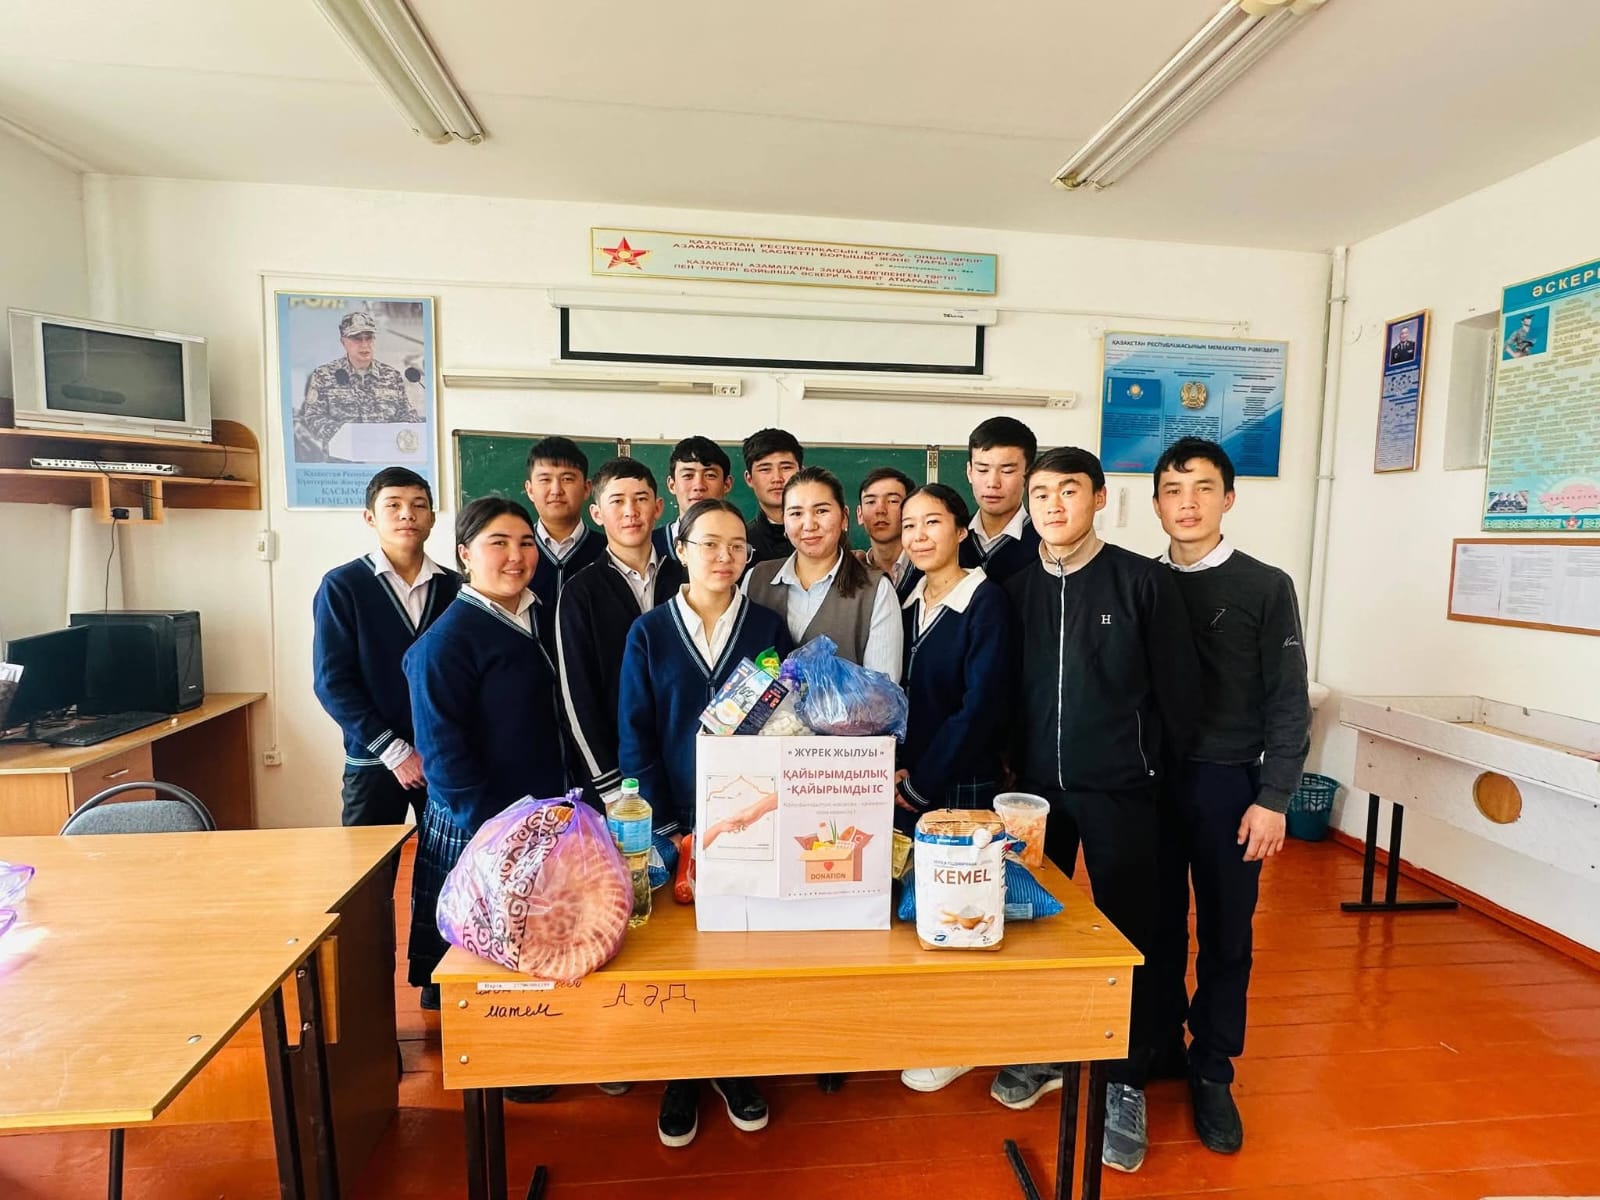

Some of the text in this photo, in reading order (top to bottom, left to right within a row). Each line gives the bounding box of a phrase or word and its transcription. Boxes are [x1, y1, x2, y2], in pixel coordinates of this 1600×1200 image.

[1101, 614, 1112, 625] H
[794, 748, 878, 758] ЖҮРЕК ЖЫЛУЫ
[783, 768, 888, 781] ҚАЙЫРЫМДЫЛЫҚ
[811, 872, 847, 880] DONATION
[934, 869, 992, 885] KEMEL
